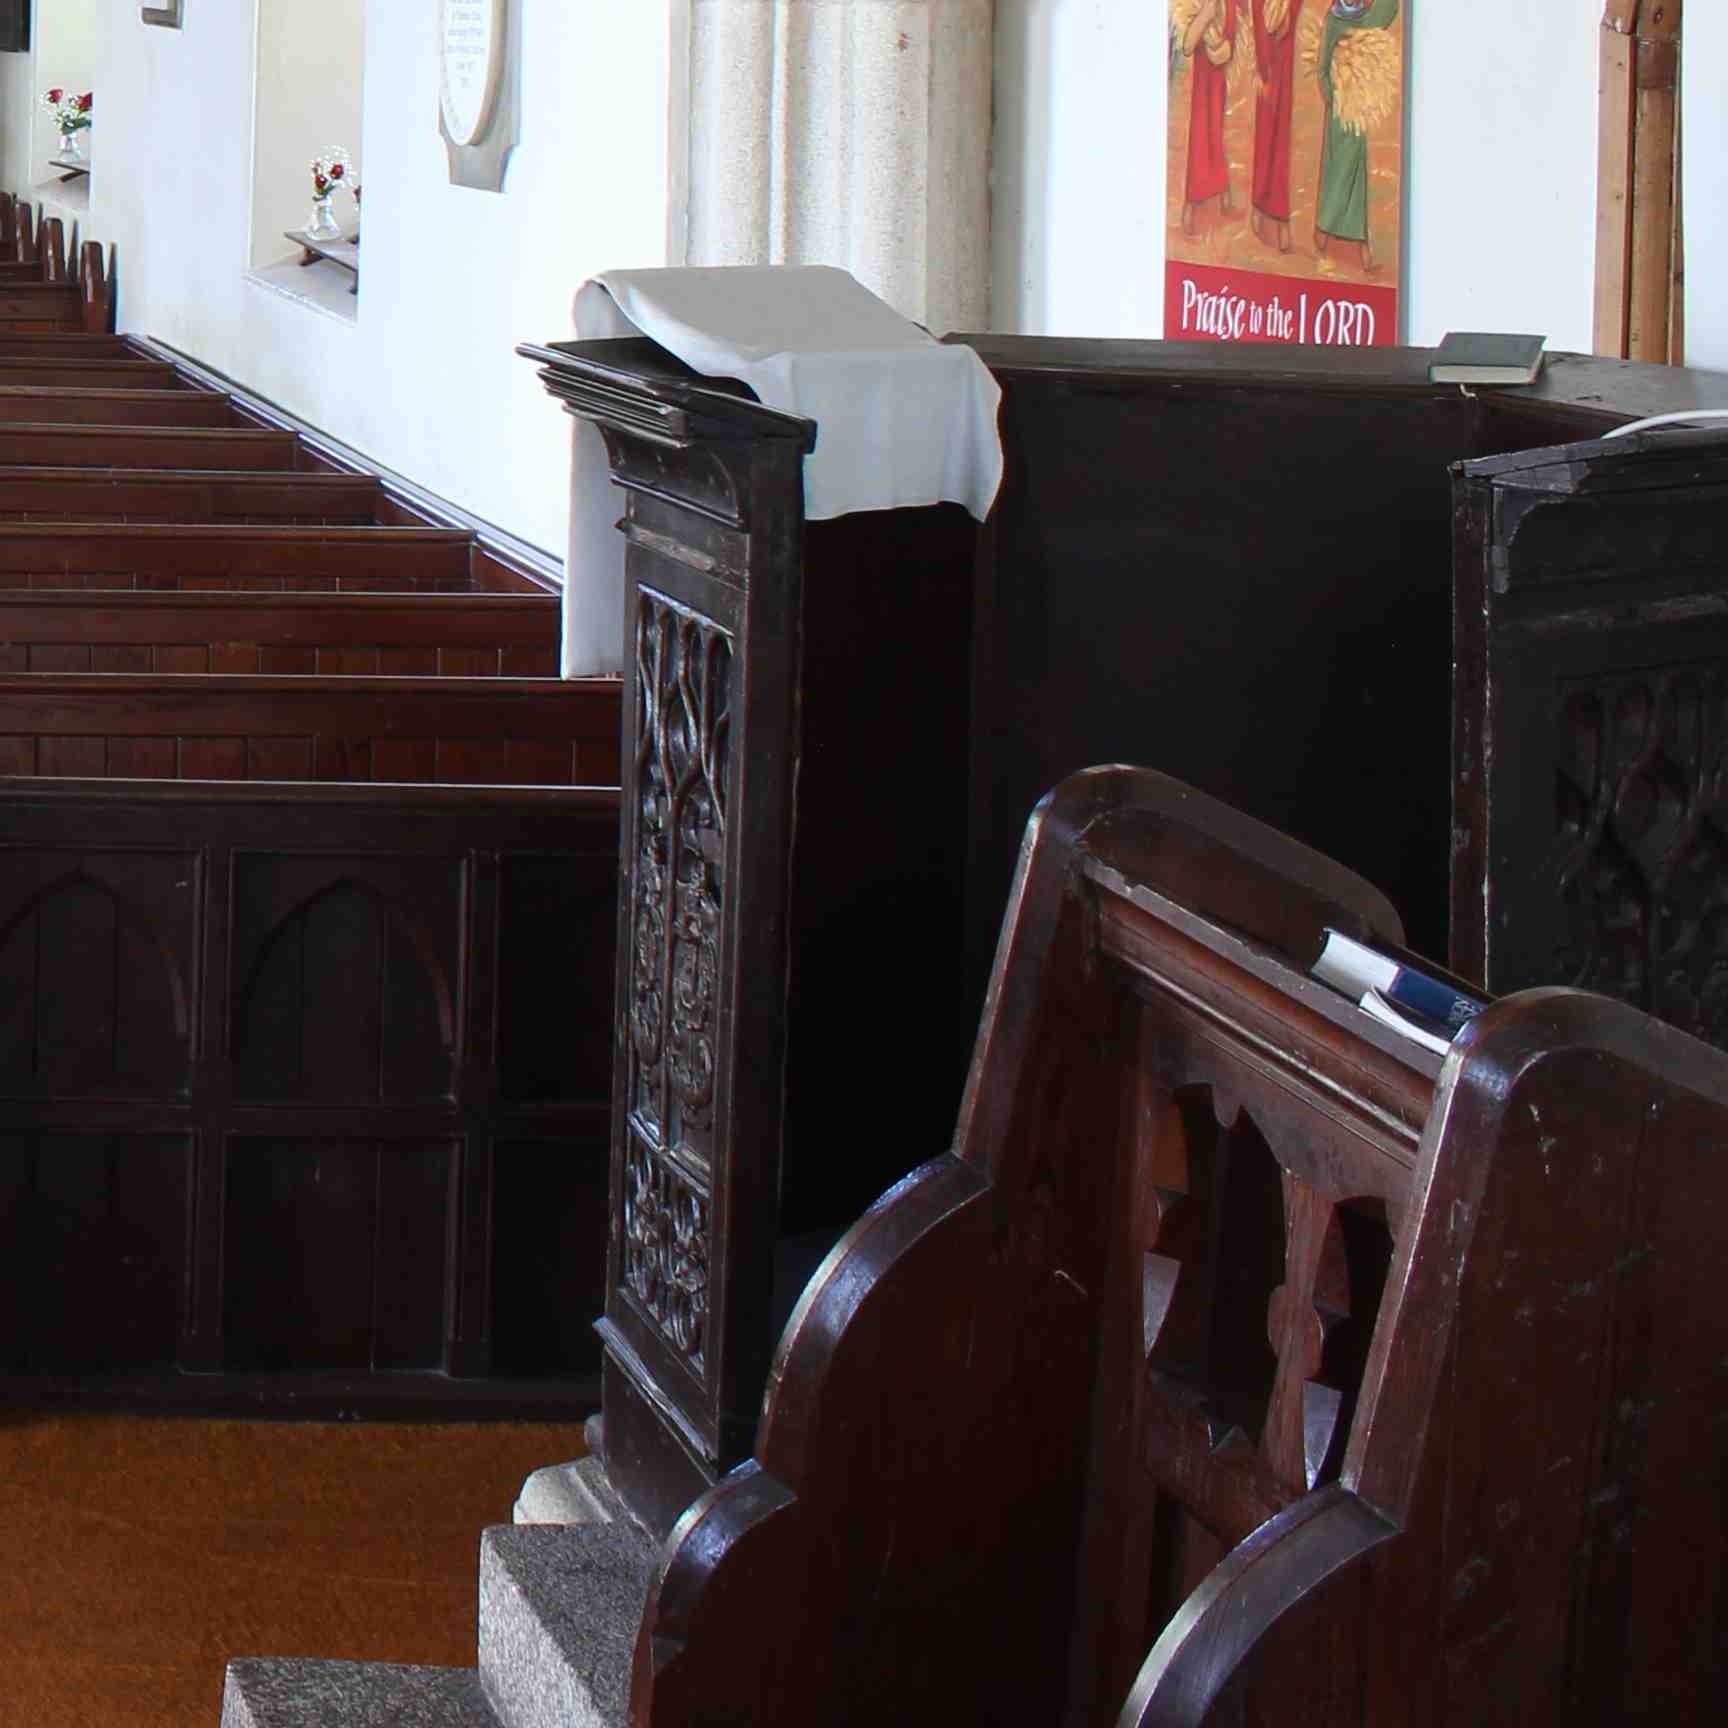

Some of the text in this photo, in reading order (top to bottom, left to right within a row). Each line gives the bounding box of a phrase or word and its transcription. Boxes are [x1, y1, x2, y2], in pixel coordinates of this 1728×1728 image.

[1182, 279, 1246, 340] Praise
[1248, 300, 1263, 335] to
[1266, 296, 1295, 340] the
